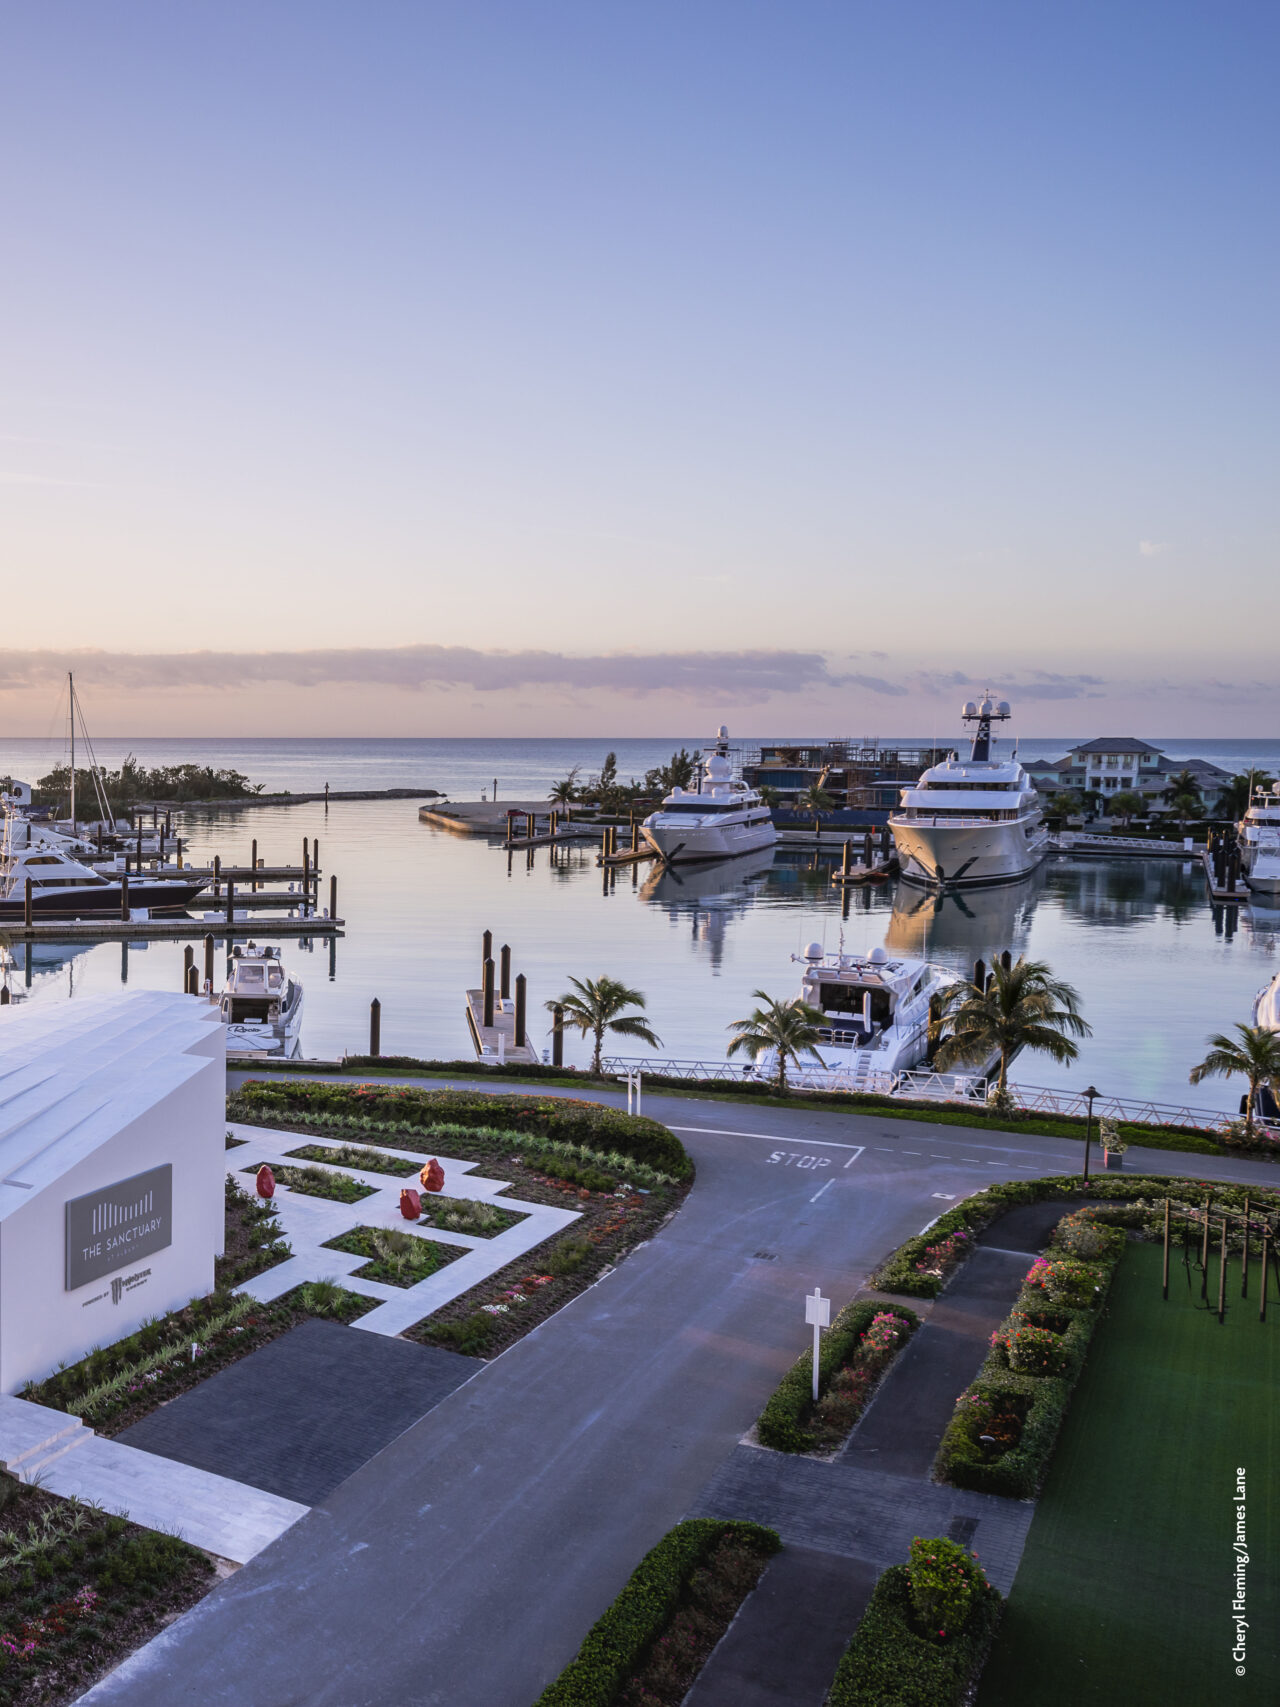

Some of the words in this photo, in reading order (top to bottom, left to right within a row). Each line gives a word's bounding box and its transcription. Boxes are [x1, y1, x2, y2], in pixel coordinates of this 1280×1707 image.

[765, 1151, 832, 1170] STOP
[82, 1242, 102, 1261] THE
[106, 1217, 162, 1251] SANCTUARY
